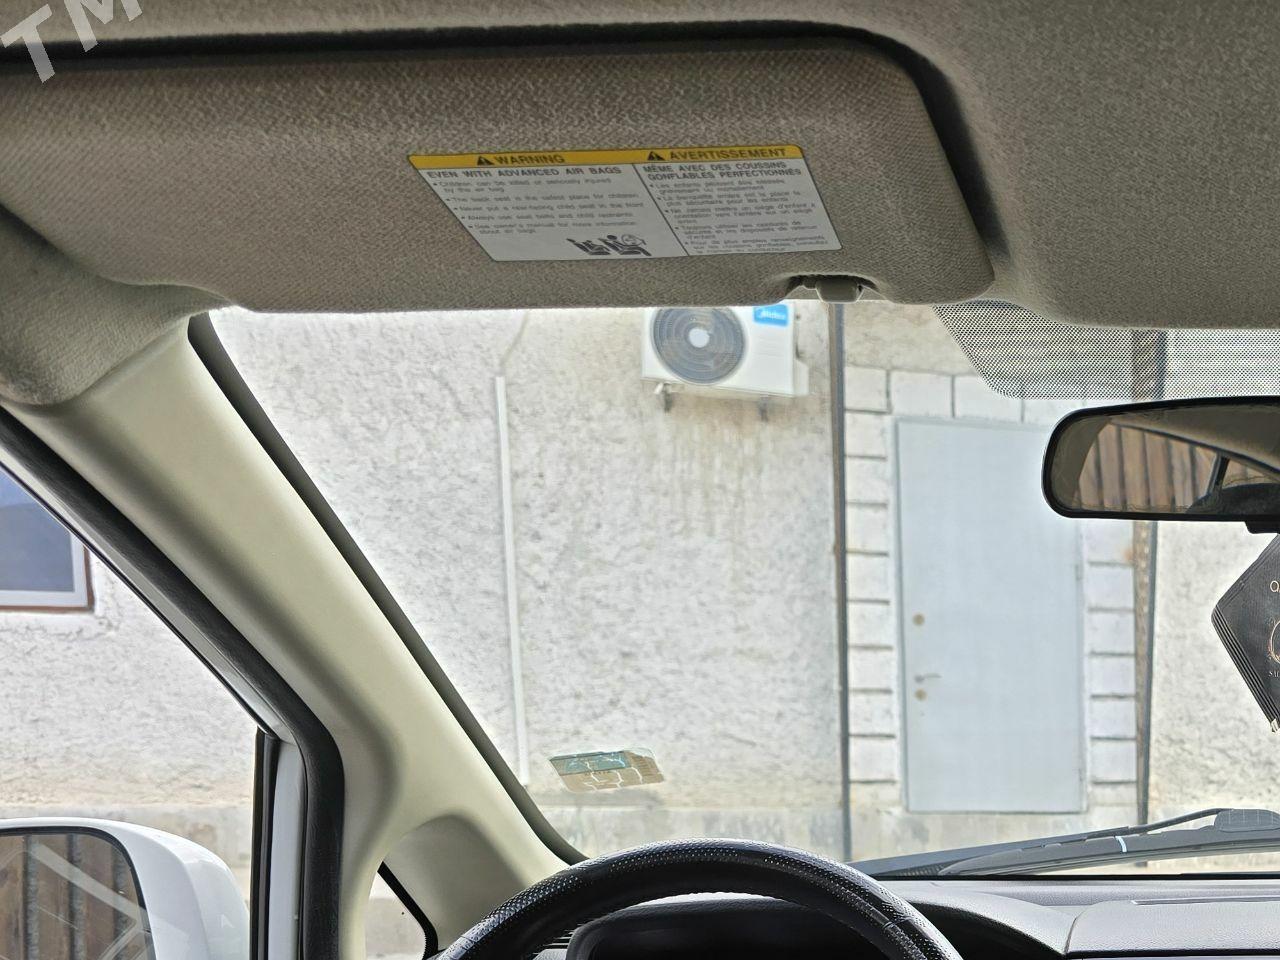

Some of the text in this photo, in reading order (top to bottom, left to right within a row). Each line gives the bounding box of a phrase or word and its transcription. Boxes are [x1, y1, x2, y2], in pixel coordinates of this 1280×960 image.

[495, 155, 566, 165] WARNING
[669, 149, 788, 161] AVERTISSEMENT
[678, 163, 707, 172] AVEC
[711, 162, 732, 171] DES
[735, 161, 788, 170] COUSSINS
[426, 166, 623, 179] EVEN WITH ADVANCED AIR BAGS
[648, 171, 715, 181] GONFLABLES
